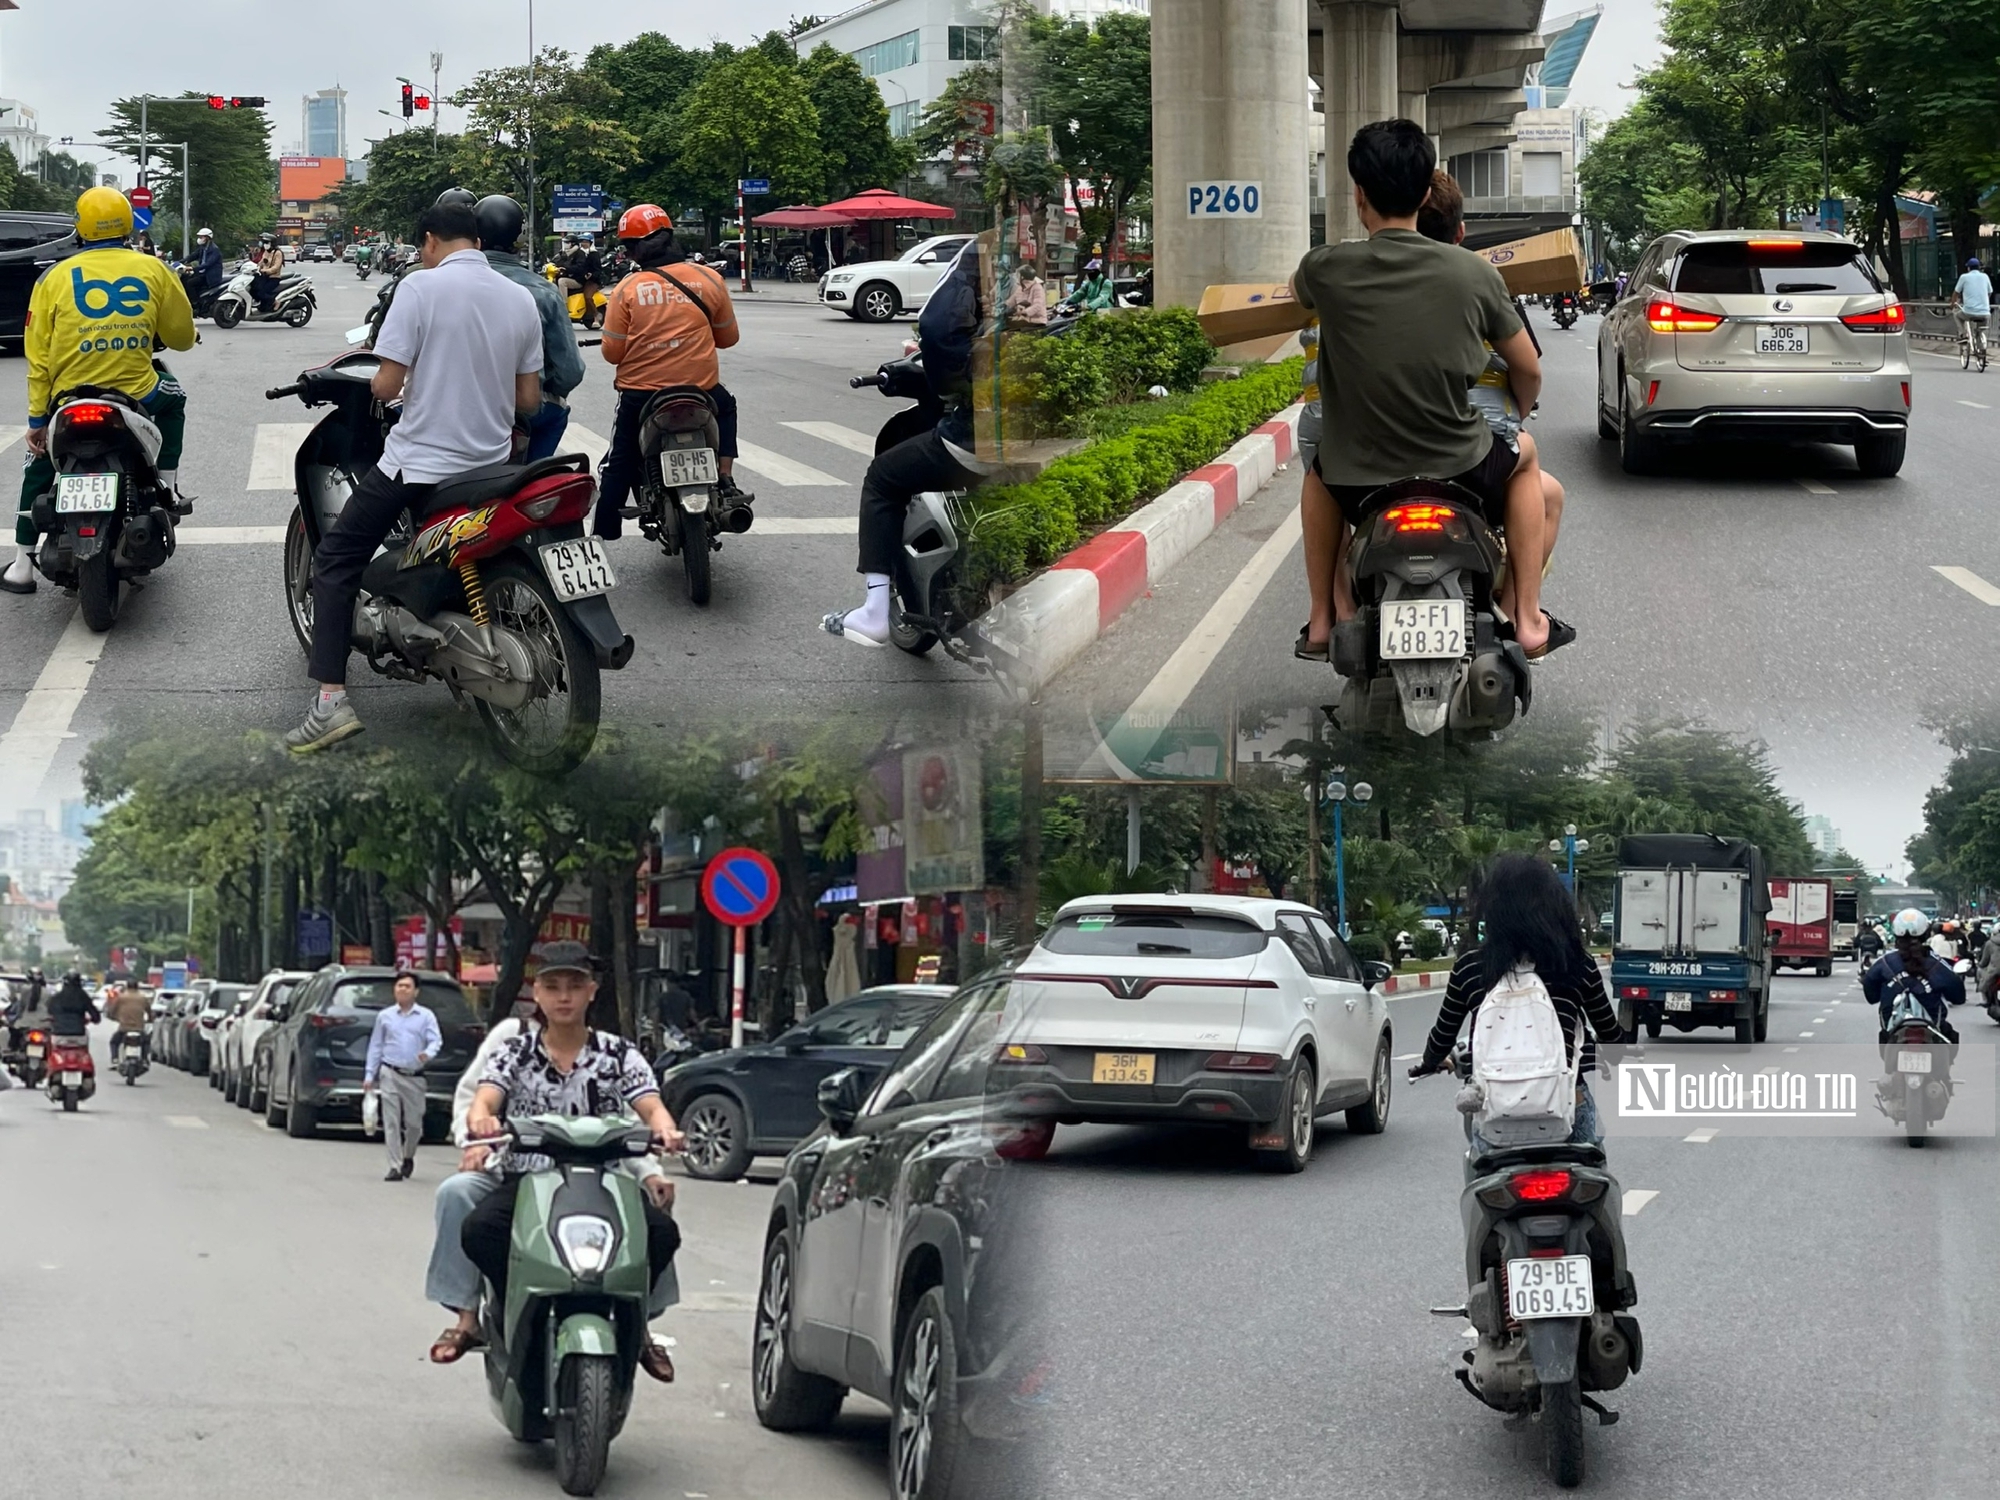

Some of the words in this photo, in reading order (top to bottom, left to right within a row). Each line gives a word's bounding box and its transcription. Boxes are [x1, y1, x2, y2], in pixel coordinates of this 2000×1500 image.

[209, 97, 224, 109] 49
[1190, 185, 1258, 215] P260
[71, 266, 150, 319] be
[93, 323, 113, 332] nhau
[1771, 327, 1793, 339] 30G
[1761, 340, 1803, 352] 686.28
[670, 451, 707, 467] 90-H5
[671, 466, 709, 483] 5141
[67, 477, 108, 493] 99-E1
[60, 494, 111, 510] 614.64
[562, 566, 611, 595] 6442
[1394, 605, 1449, 628] 43-F1
[1387, 630, 1459, 654] 488.32
[1112, 1055, 1138, 1068] 36H
[1102, 1069, 1148, 1082] 133.45
[1520, 1262, 1577, 1287] 29-BE
[1516, 1287, 1587, 1314] 069.45
